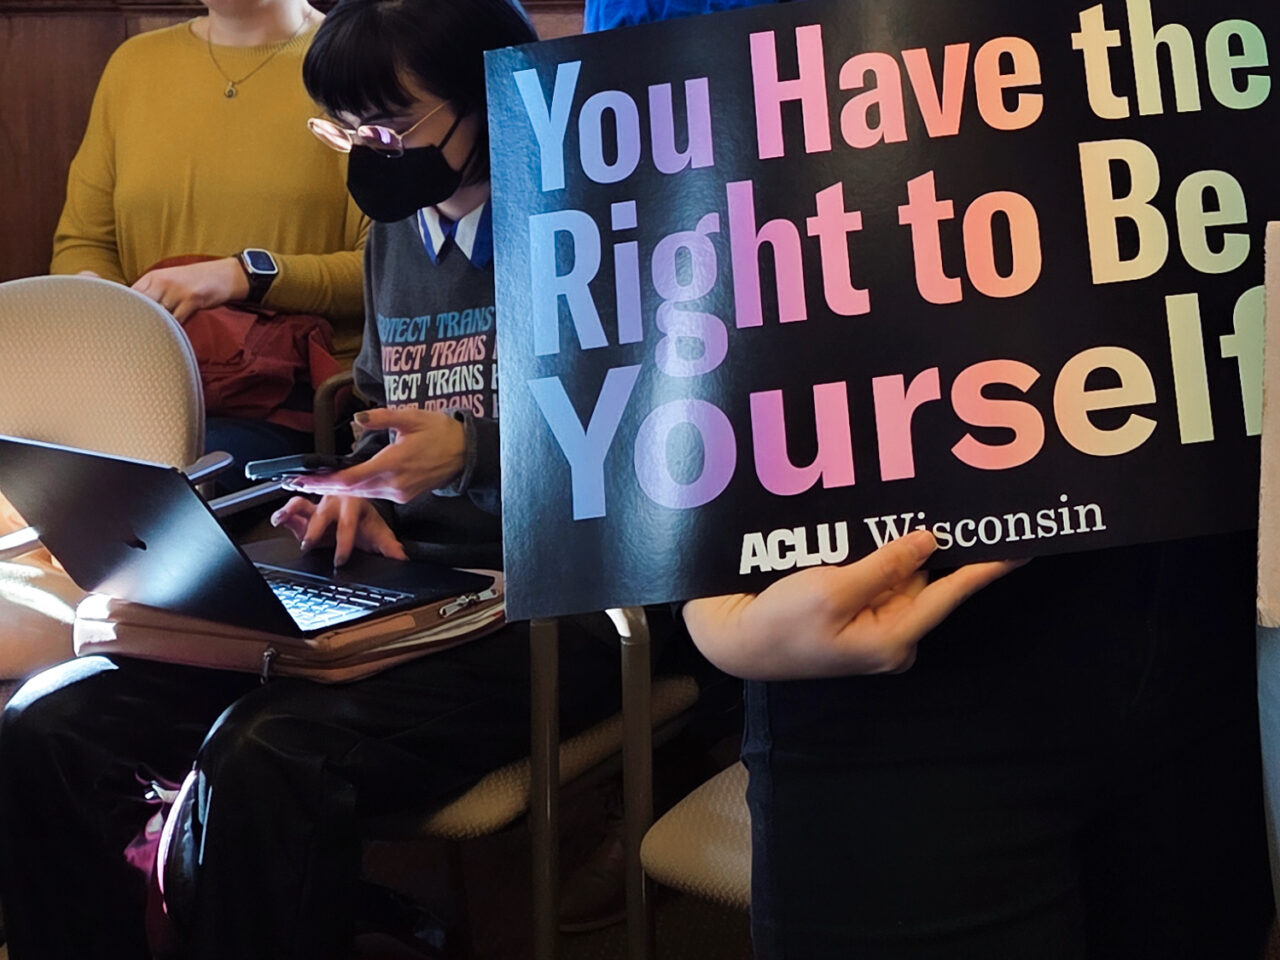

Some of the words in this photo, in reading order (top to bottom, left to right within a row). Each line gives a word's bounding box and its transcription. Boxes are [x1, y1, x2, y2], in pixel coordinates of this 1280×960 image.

[513, 61, 715, 192] You
[749, 24, 1044, 160] Have
[530, 179, 871, 378] Right
[898, 170, 1042, 307] to
[1078, 138, 1251, 285] Be
[436, 306, 494, 339] TRANS
[381, 344, 427, 372] TECT
[430, 334, 487, 367] TRANS
[426, 364, 484, 397] TRANS
[528, 285, 1265, 521] Yourself
[739, 521, 849, 574] ACLU
